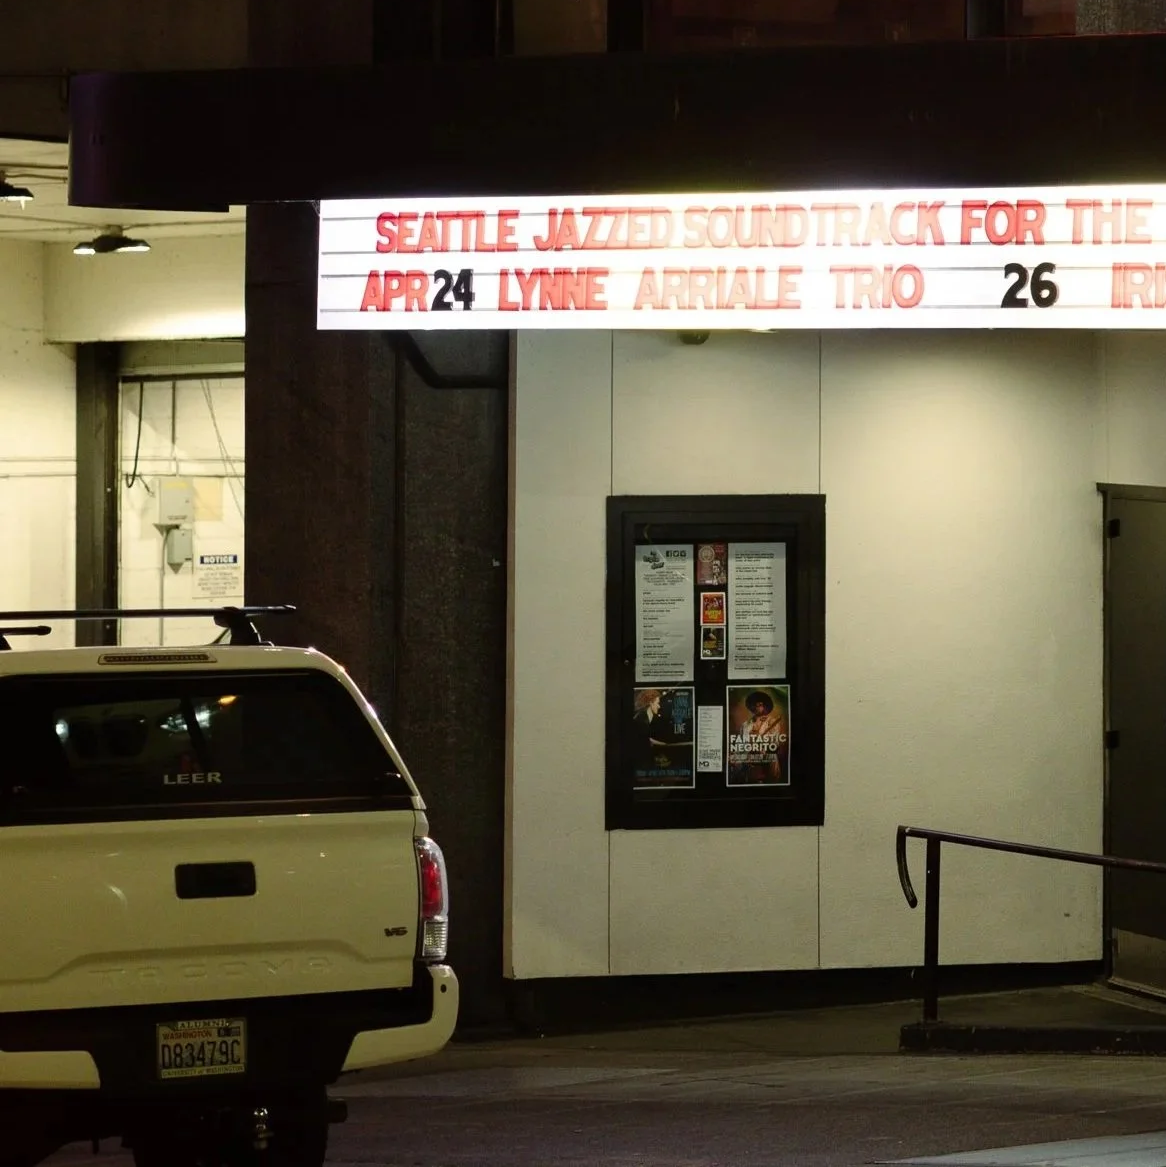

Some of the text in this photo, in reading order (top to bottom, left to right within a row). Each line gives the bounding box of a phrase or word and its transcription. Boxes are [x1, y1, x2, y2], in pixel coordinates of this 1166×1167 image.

[375, 210, 520, 253] SEATTLE
[533, 207, 673, 251] JAZZED
[959, 200, 1047, 245] FOR
[1066, 197, 1153, 245] THE
[499, 267, 609, 311] LYNNE
[633, 265, 802, 310] ARRIALE
[829, 263, 925, 309] TRIO
[1000, 262, 1060, 308] 26
[203, 555, 235, 564] NOTICE
[730, 734, 787, 743] FANTASTIC
[730, 743, 778, 752] NEGRITO
[163, 772, 222, 786] LEER
[384, 927, 408, 937] V6
[162, 1029, 213, 1040] WASHINGTON
[161, 1040, 241, 1069] D83479C
